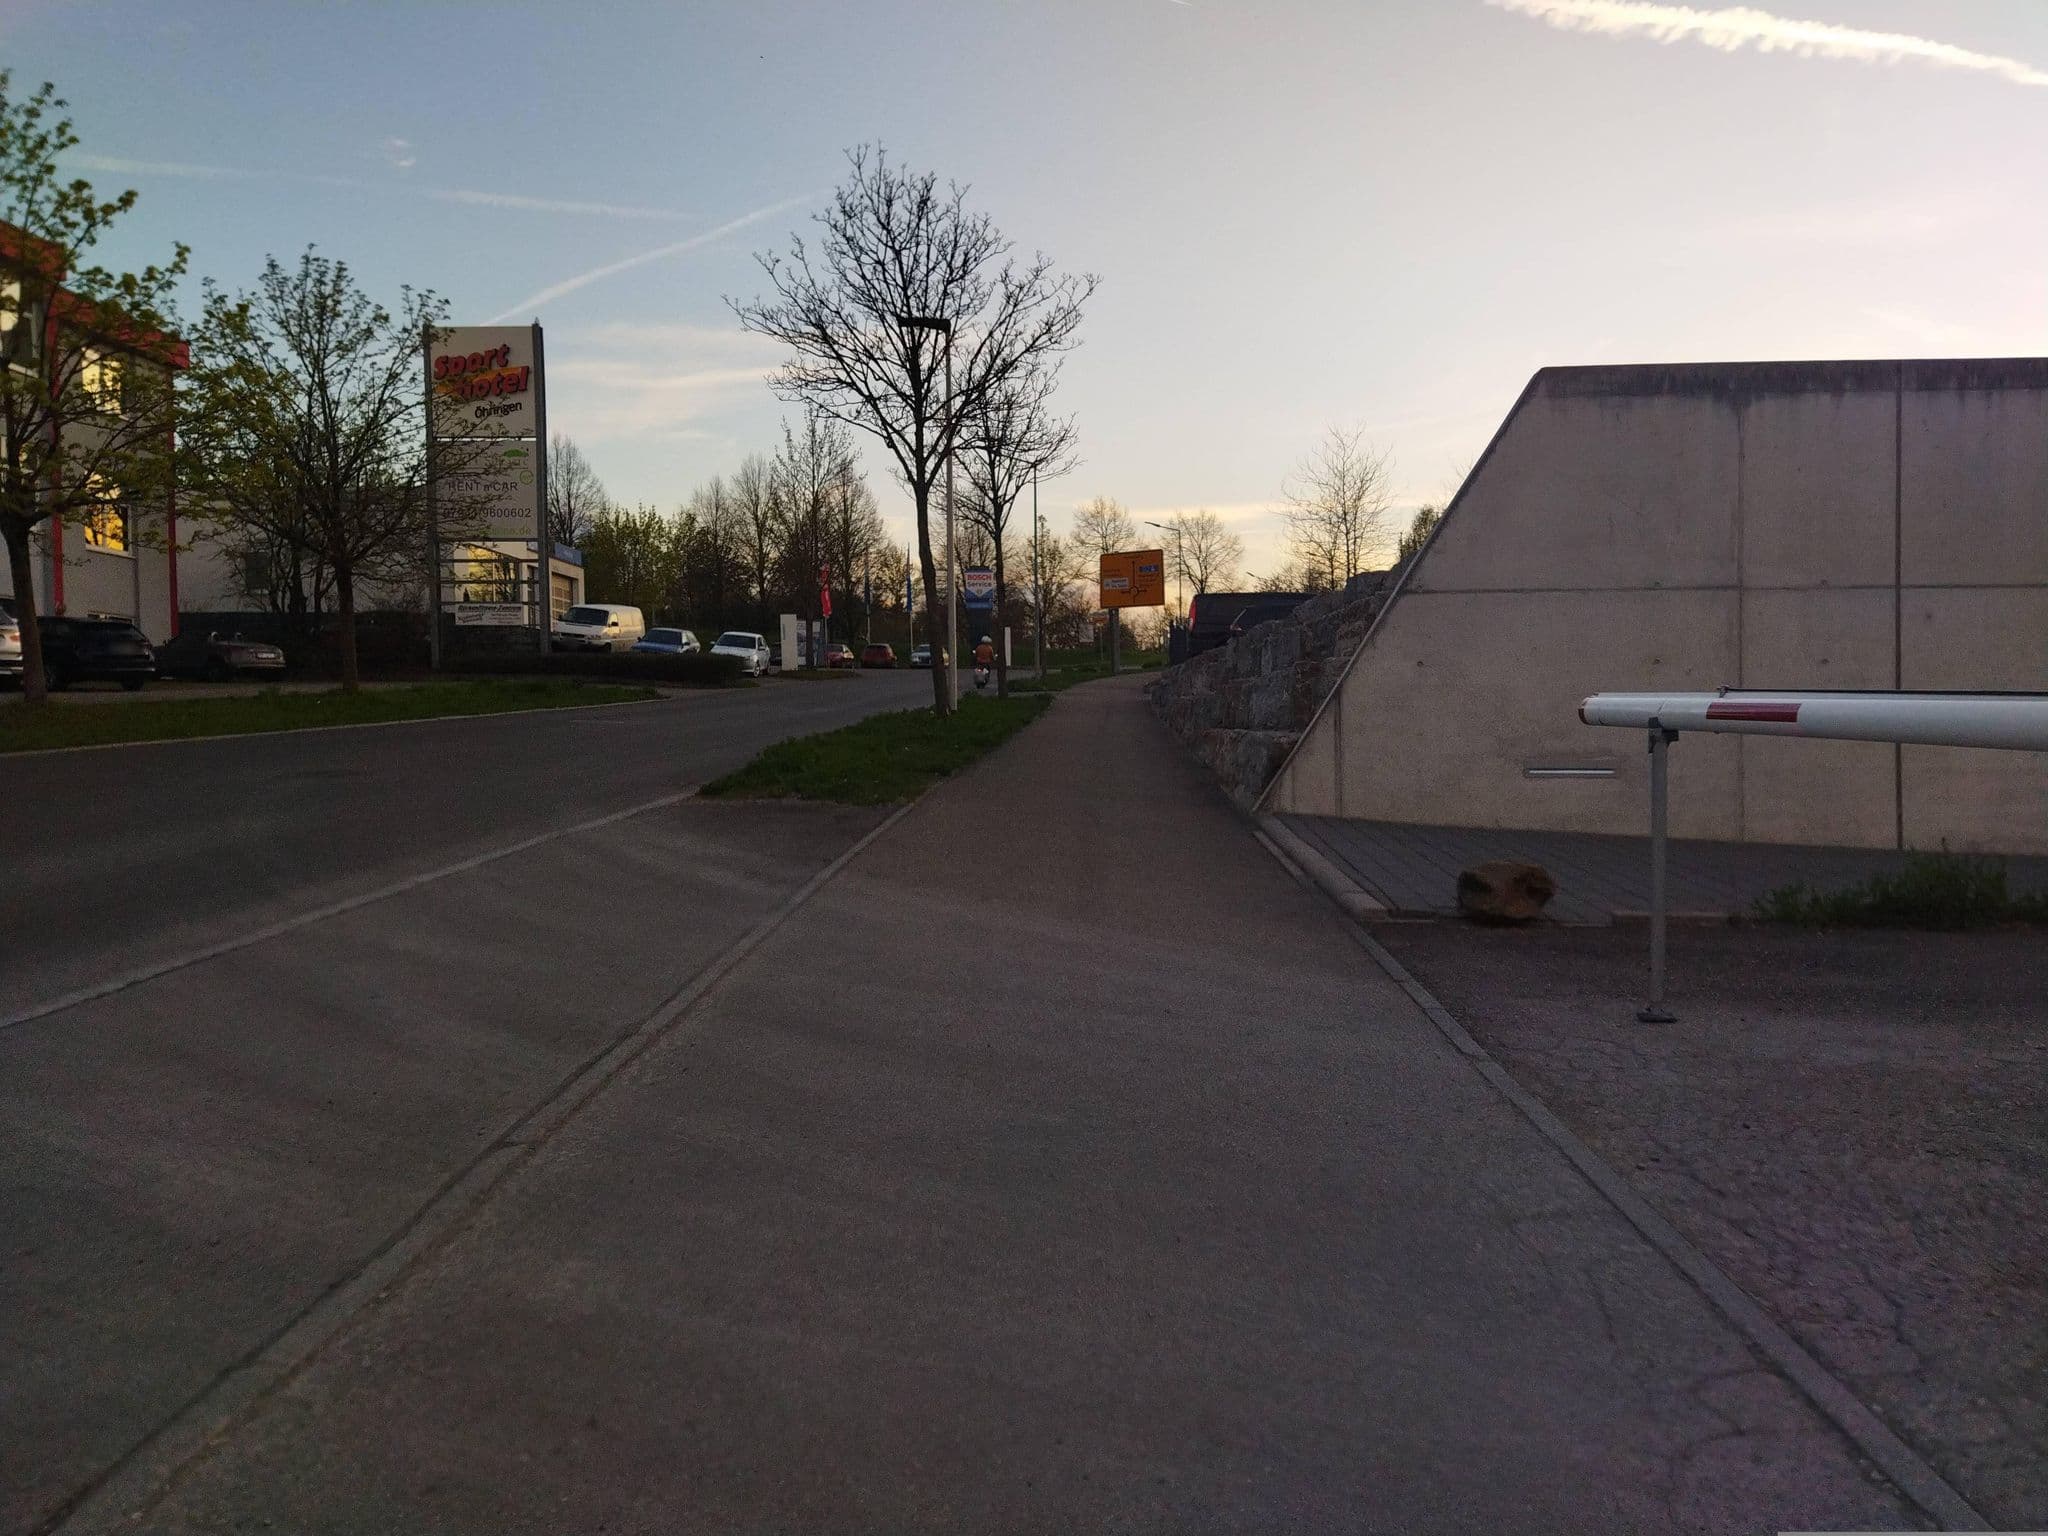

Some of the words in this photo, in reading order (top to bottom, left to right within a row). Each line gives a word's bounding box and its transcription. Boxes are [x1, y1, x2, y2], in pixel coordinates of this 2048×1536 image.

[475, 402, 523, 418] Öhringen
[448, 481, 480, 491] RENT
[493, 481, 518, 491] CAR
